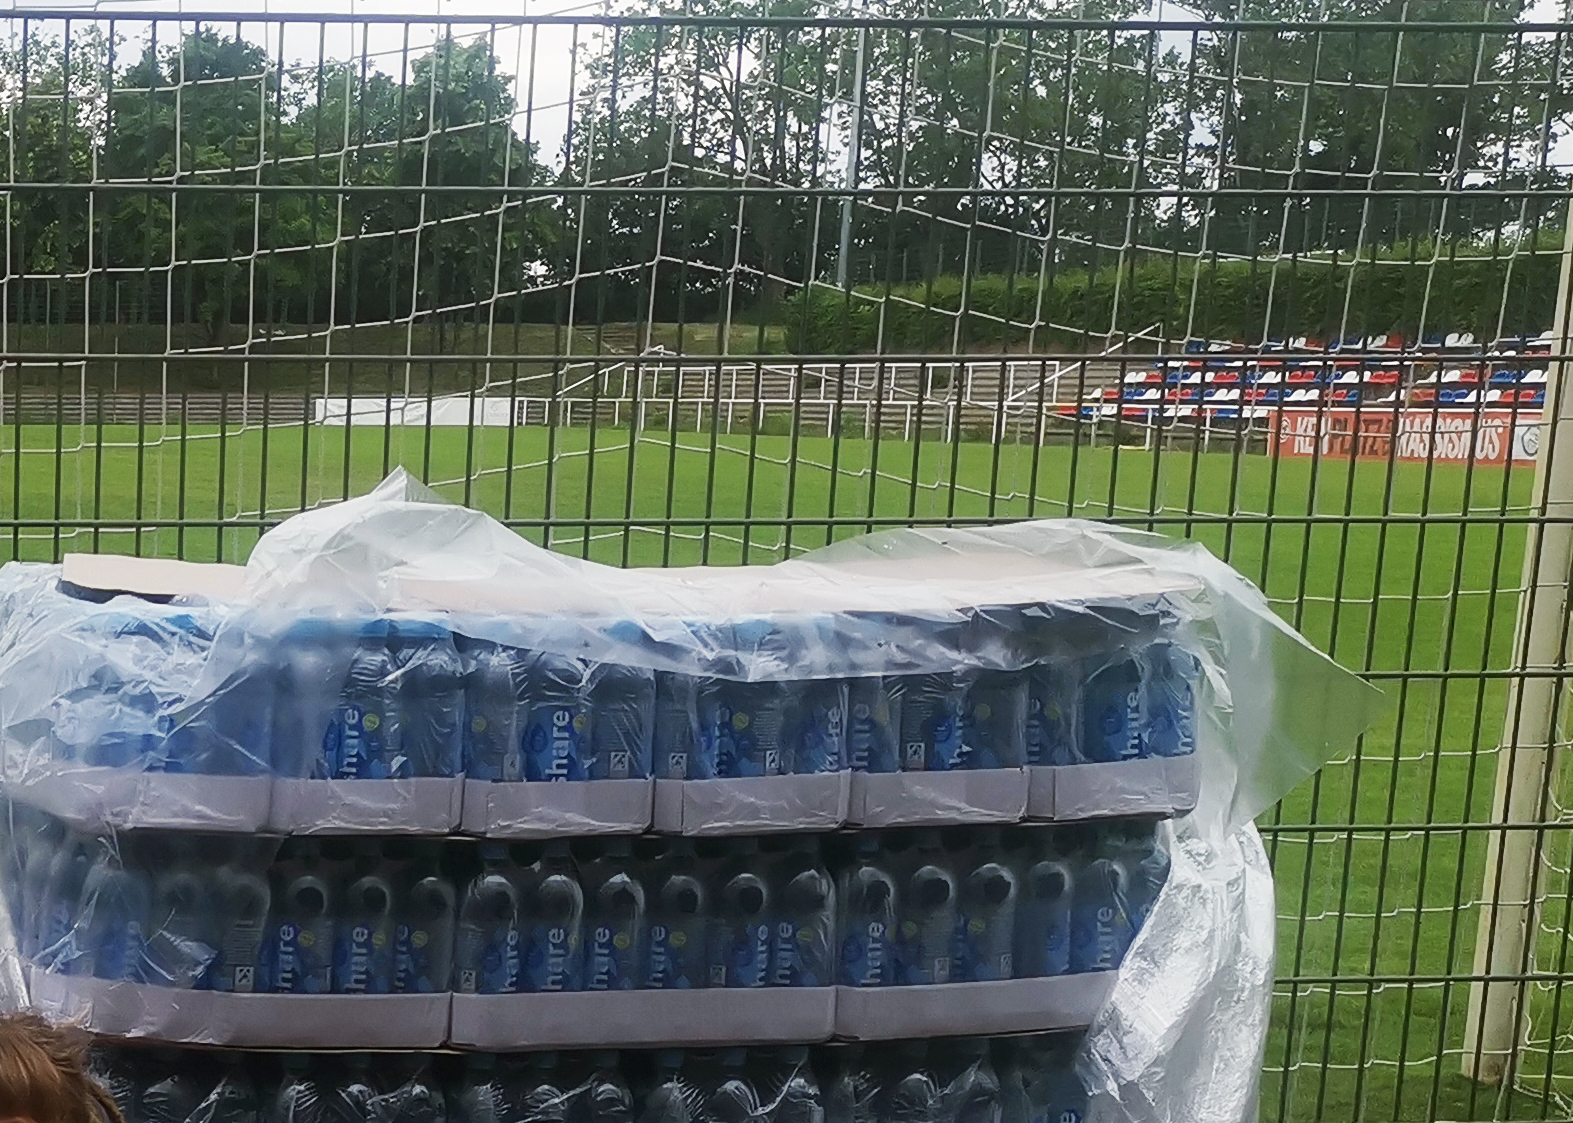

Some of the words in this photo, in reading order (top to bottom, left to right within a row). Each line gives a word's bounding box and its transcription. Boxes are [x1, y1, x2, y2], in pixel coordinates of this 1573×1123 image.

[339, 707, 359, 779] hare
[1120, 690, 1139, 755] hare
[277, 925, 294, 993] hare
[347, 926, 368, 994] hare
[502, 928, 519, 992] hare
[544, 928, 564, 991] hare
[589, 926, 610, 990] hare
[775, 921, 794, 985] hare
[861, 921, 885, 985] hare
